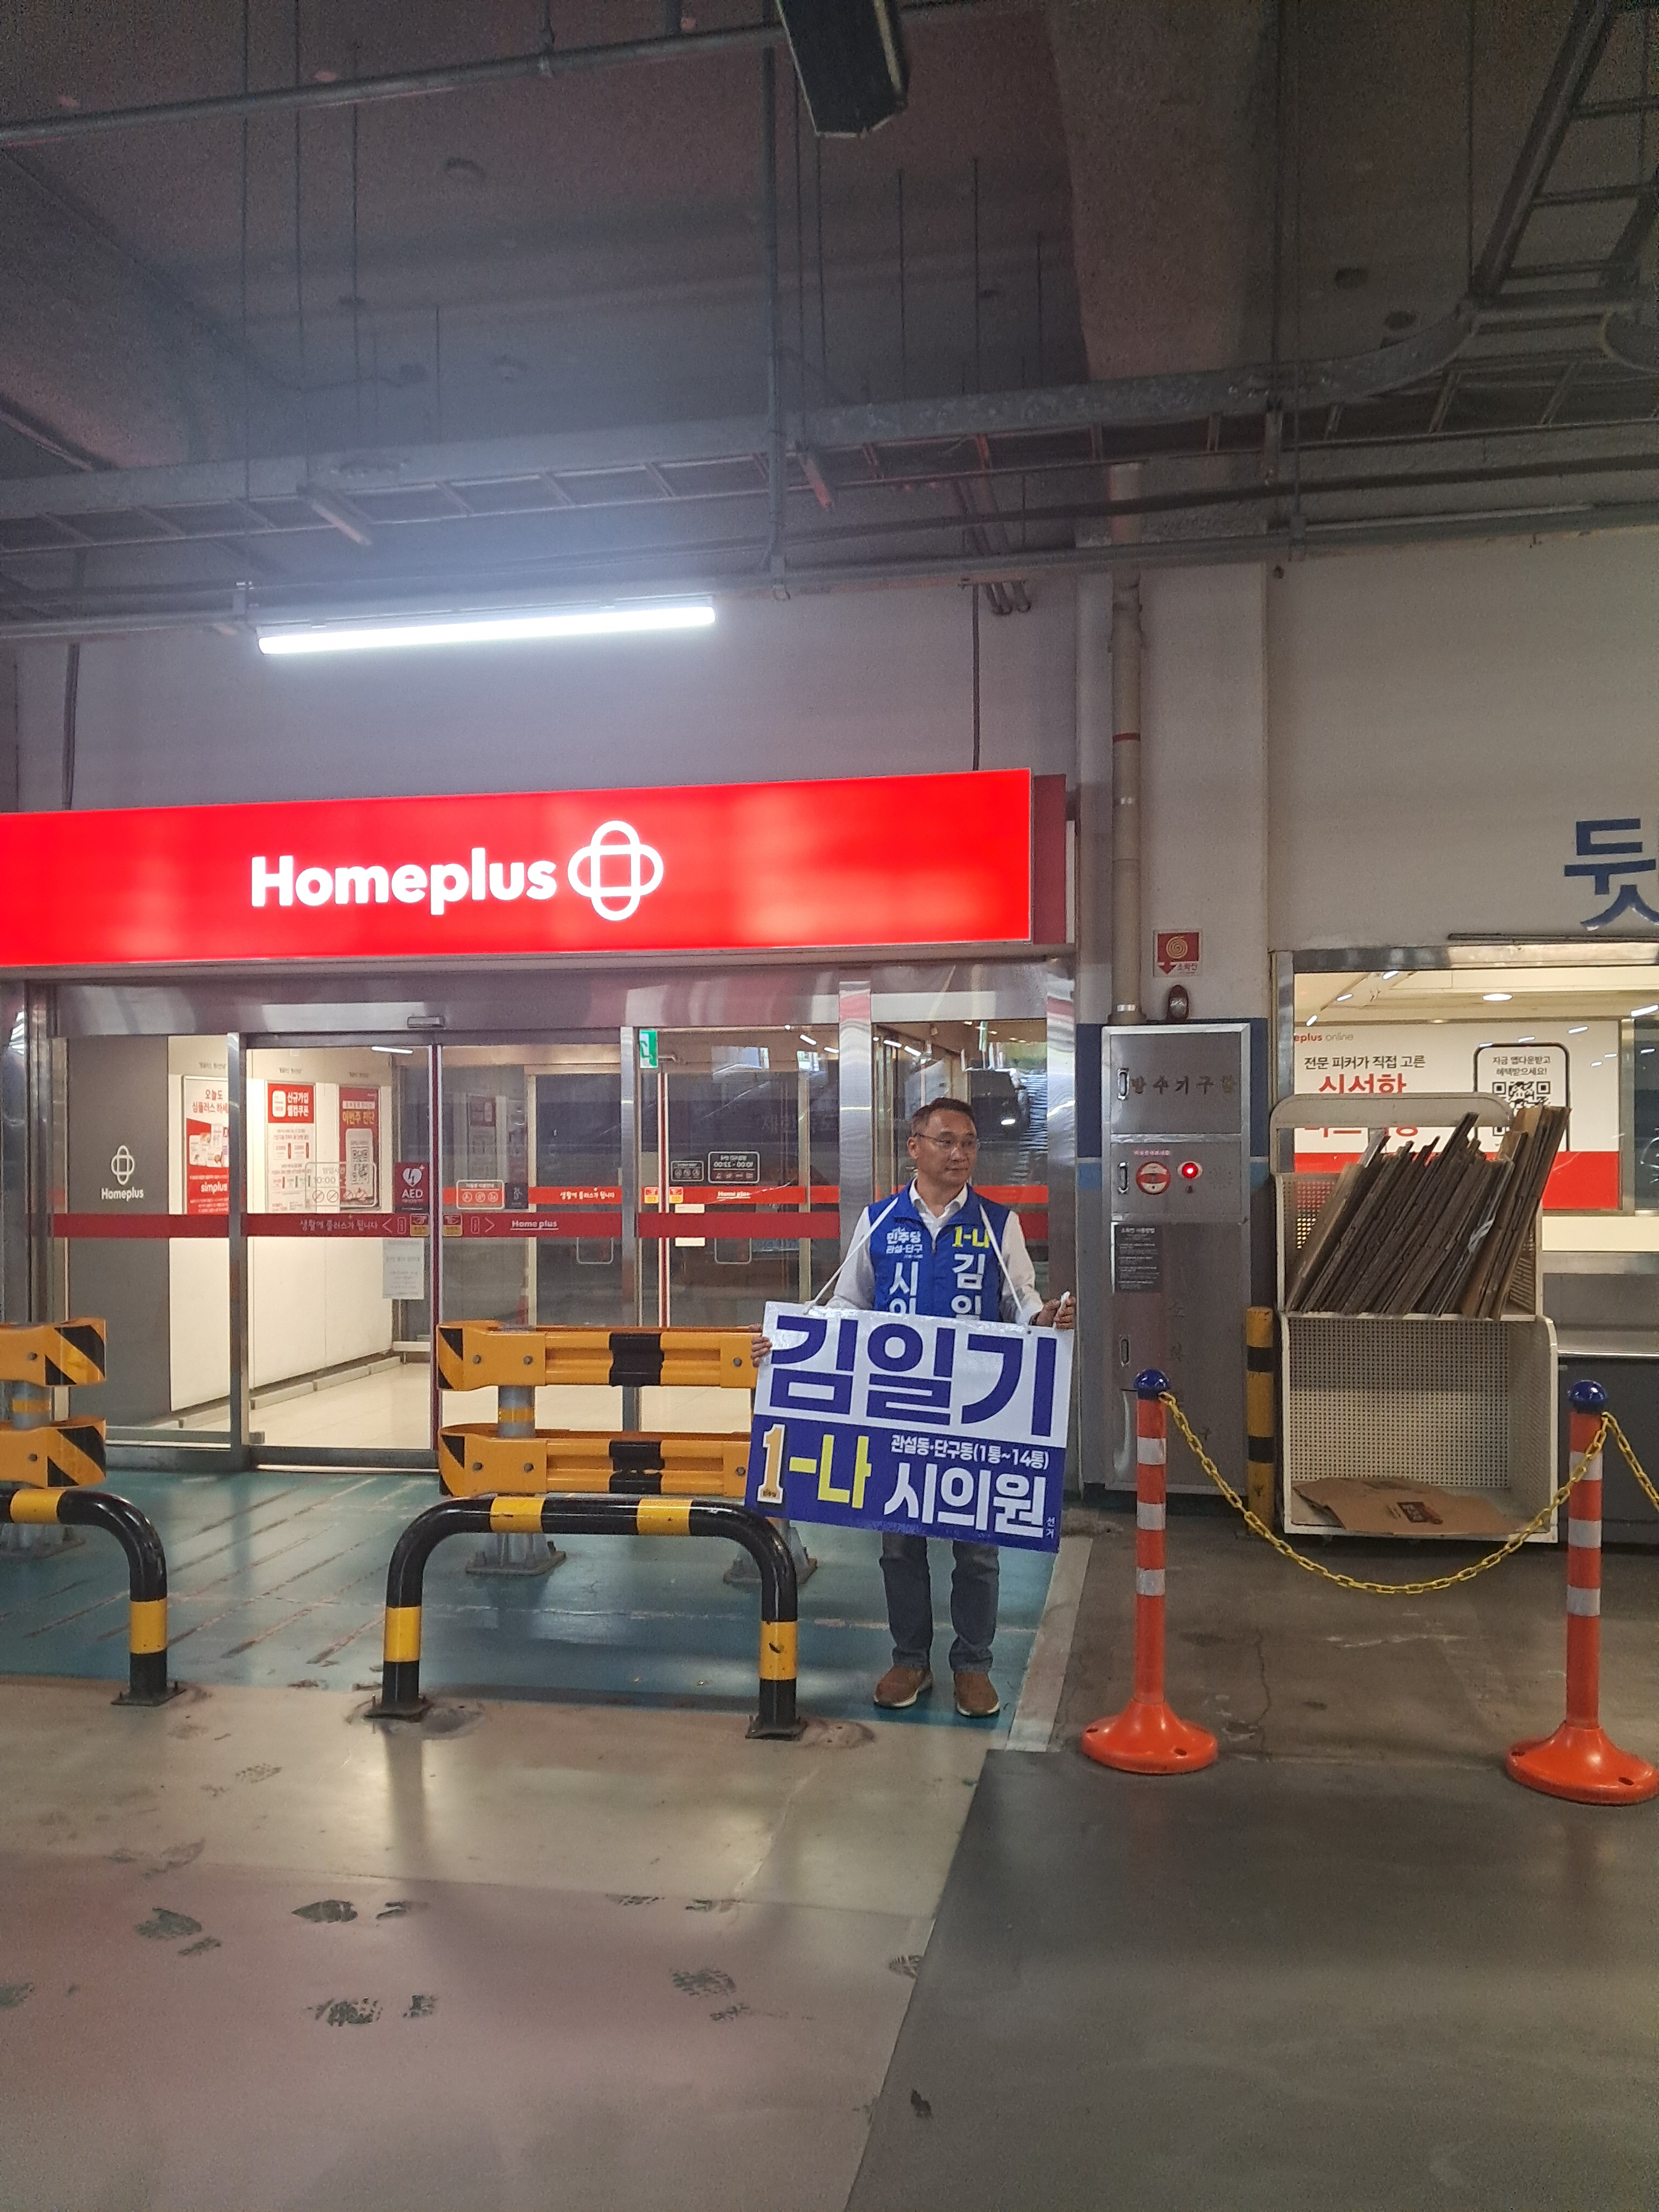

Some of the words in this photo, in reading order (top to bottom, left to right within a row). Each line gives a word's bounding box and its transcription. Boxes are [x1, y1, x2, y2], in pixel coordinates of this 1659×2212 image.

[251, 847, 557, 916] Homeplus
[1325, 1032, 1354, 1041] online
[1304, 1056, 1329, 1070] 전문
[1332, 1055, 1370, 1070] 피커가
[1373, 1055, 1397, 1069] 직접
[1400, 1055, 1426, 1068] 고른
[1493, 1056, 1508, 1065] 지금
[205, 1089, 223, 1100] 오늘도
[287, 1091, 309, 1104] 신규가입
[101, 1186, 144, 1201] Homeplus
[201, 1181, 228, 1194] simplus
[402, 1188, 423, 1198] AED
[538, 1220, 558, 1229] plus
[886, 1230, 921, 1245] 민주당
[769, 1314, 1057, 1437] 김일기
[757, 1424, 872, 1509] 1-나
[884, 1462, 1046, 1539] 시의원
